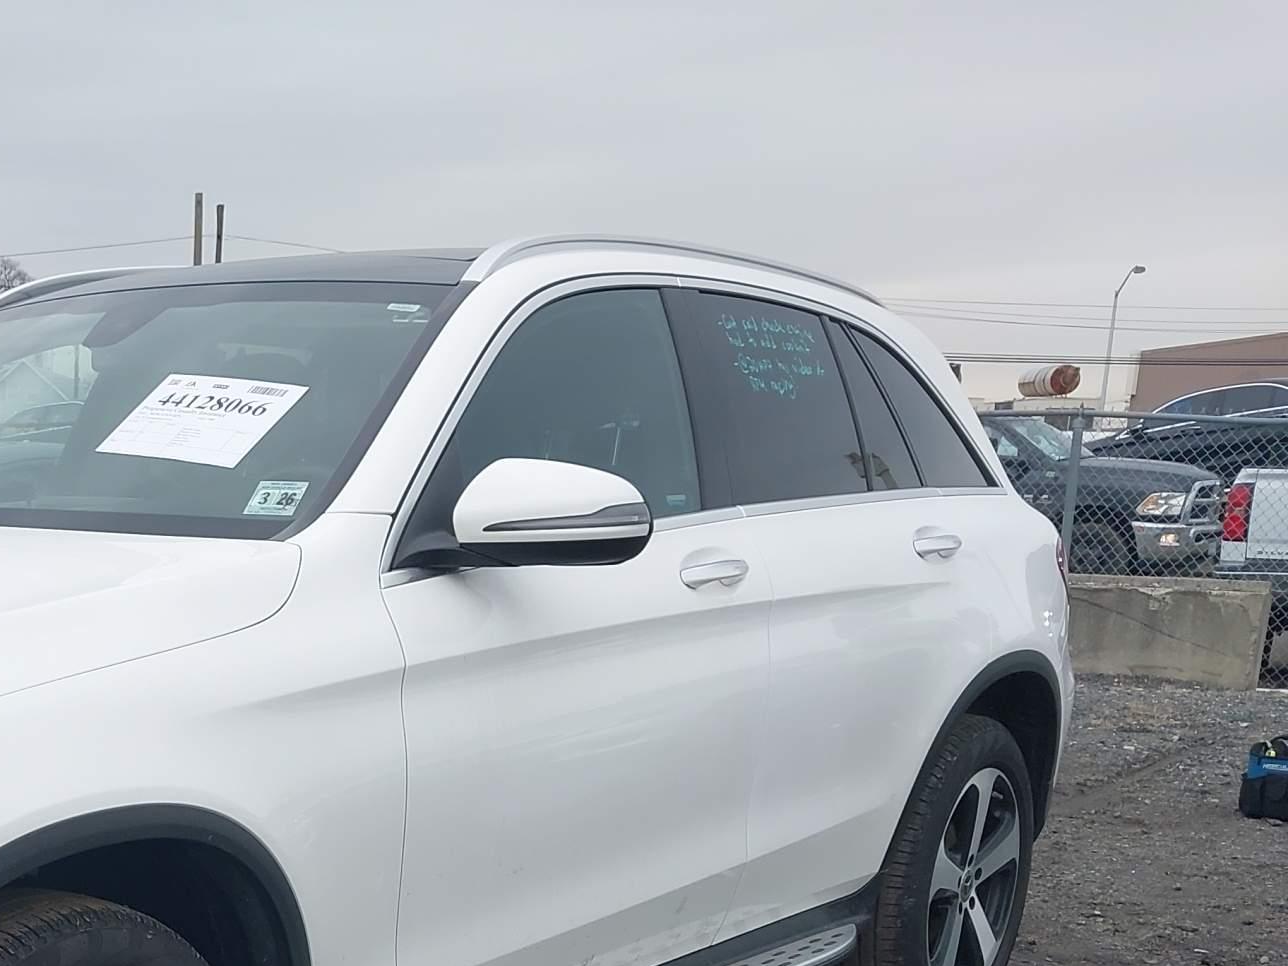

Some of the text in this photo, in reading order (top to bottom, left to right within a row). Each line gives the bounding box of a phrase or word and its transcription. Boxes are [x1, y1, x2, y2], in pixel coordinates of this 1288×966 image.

[158, 392, 274, 417] 44128066
[257, 491, 298, 507] 3 26
